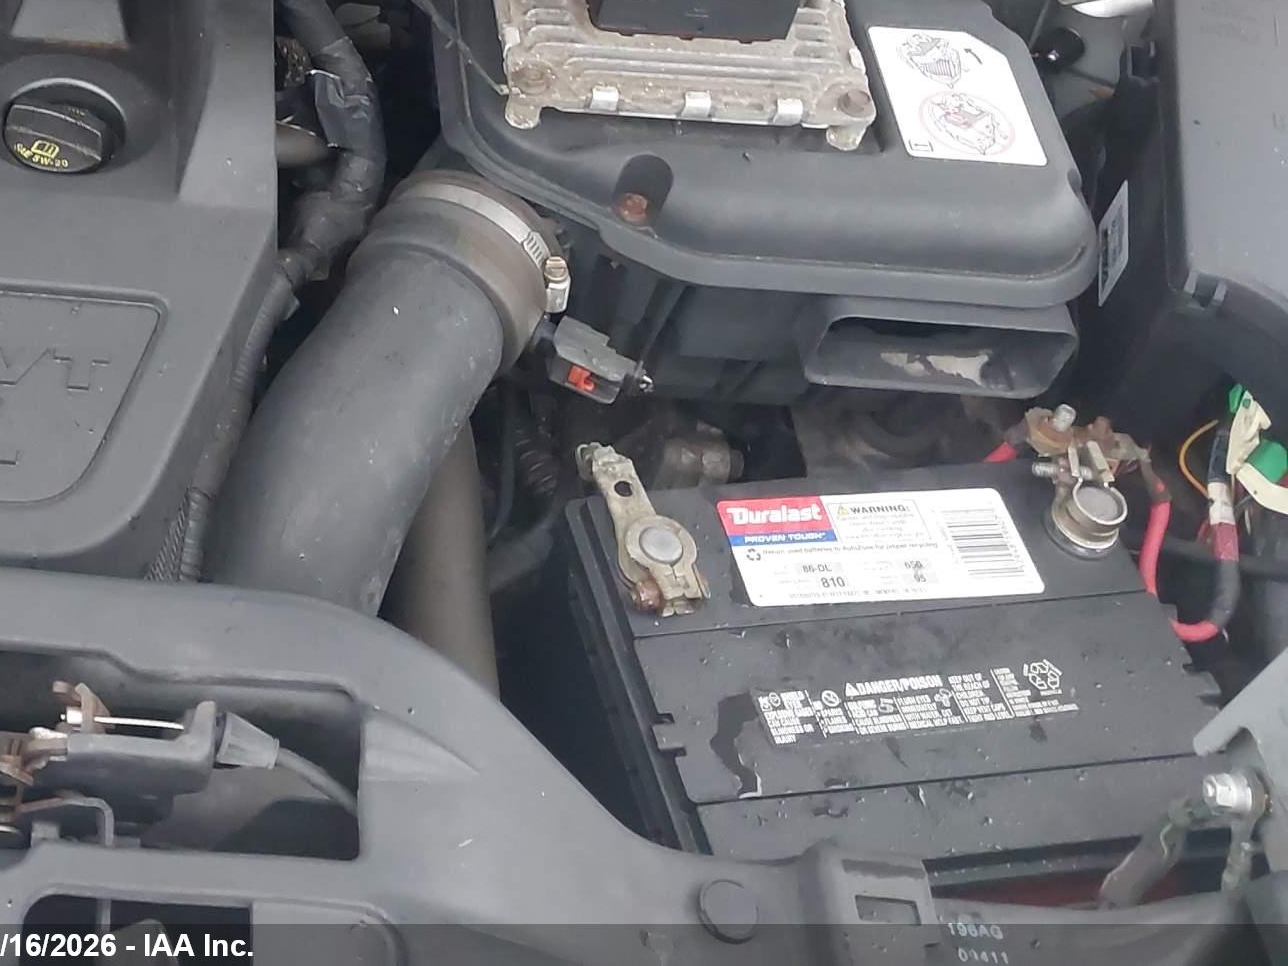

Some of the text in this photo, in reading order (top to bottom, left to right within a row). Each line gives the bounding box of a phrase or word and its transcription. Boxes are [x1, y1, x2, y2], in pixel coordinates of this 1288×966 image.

[32, 154, 69, 168] 5W-20
[726, 503, 822, 525] Duralast
[744, 533, 786, 544] PROVEN
[821, 577, 846, 588] 810
[856, 674, 943, 696] DANGER/POISON
